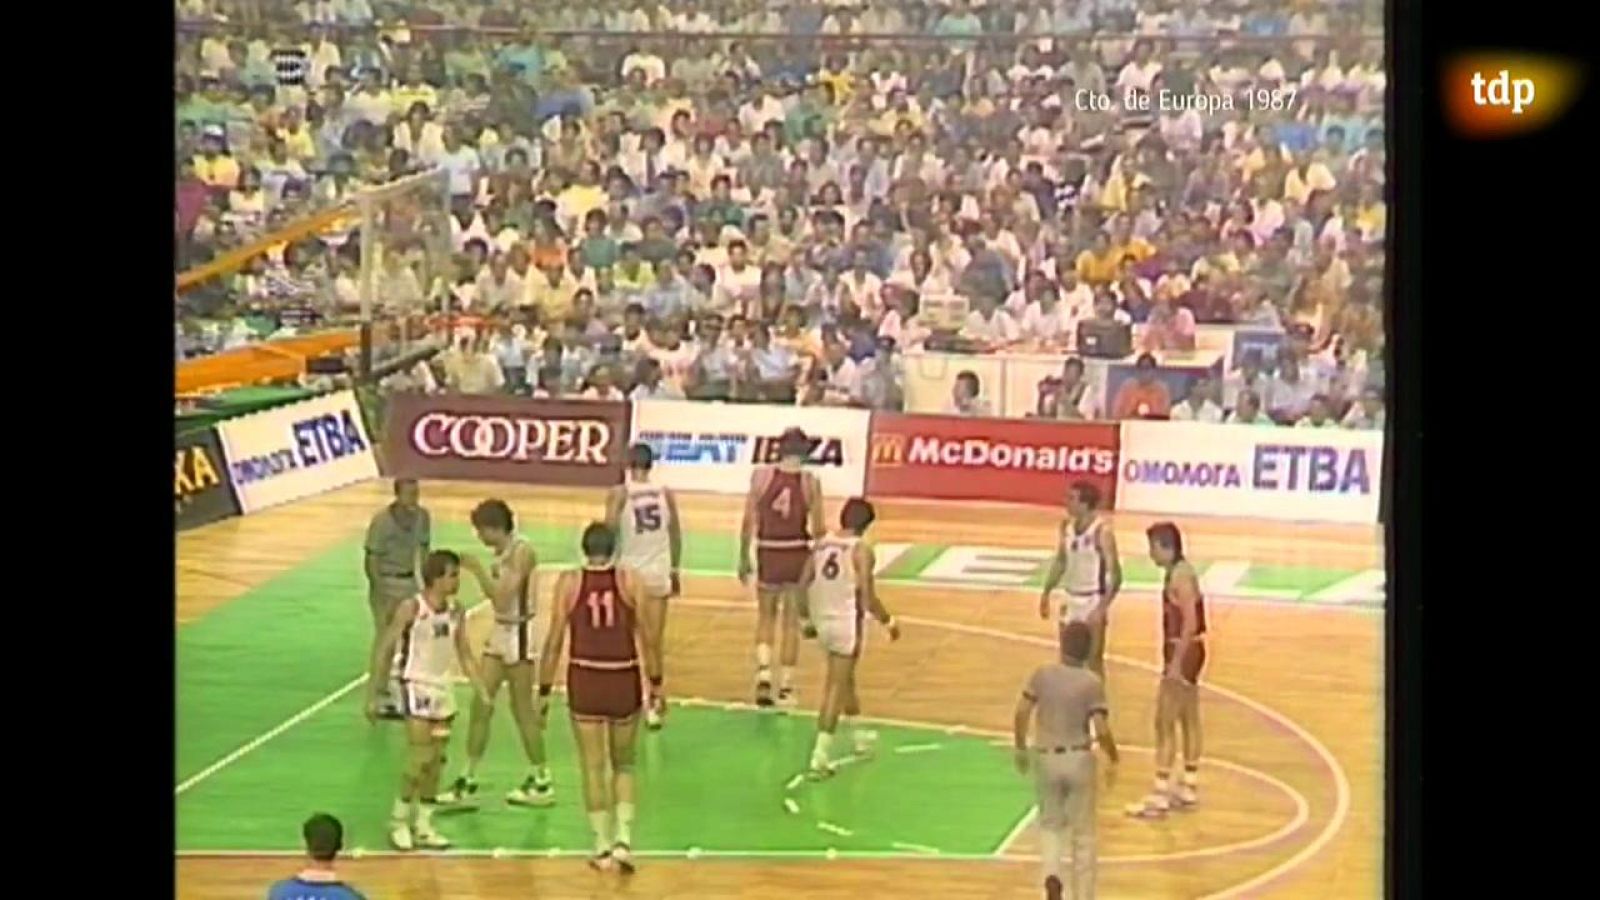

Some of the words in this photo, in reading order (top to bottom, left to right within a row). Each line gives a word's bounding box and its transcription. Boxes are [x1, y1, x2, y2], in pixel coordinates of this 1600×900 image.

[414, 412, 610, 465] COOPER
[908, 435, 1114, 474] McDonald's
[633, 503, 662, 535] 15
[771, 487, 793, 520] 4
[822, 546, 840, 581] 6
[586, 590, 615, 630] 11
